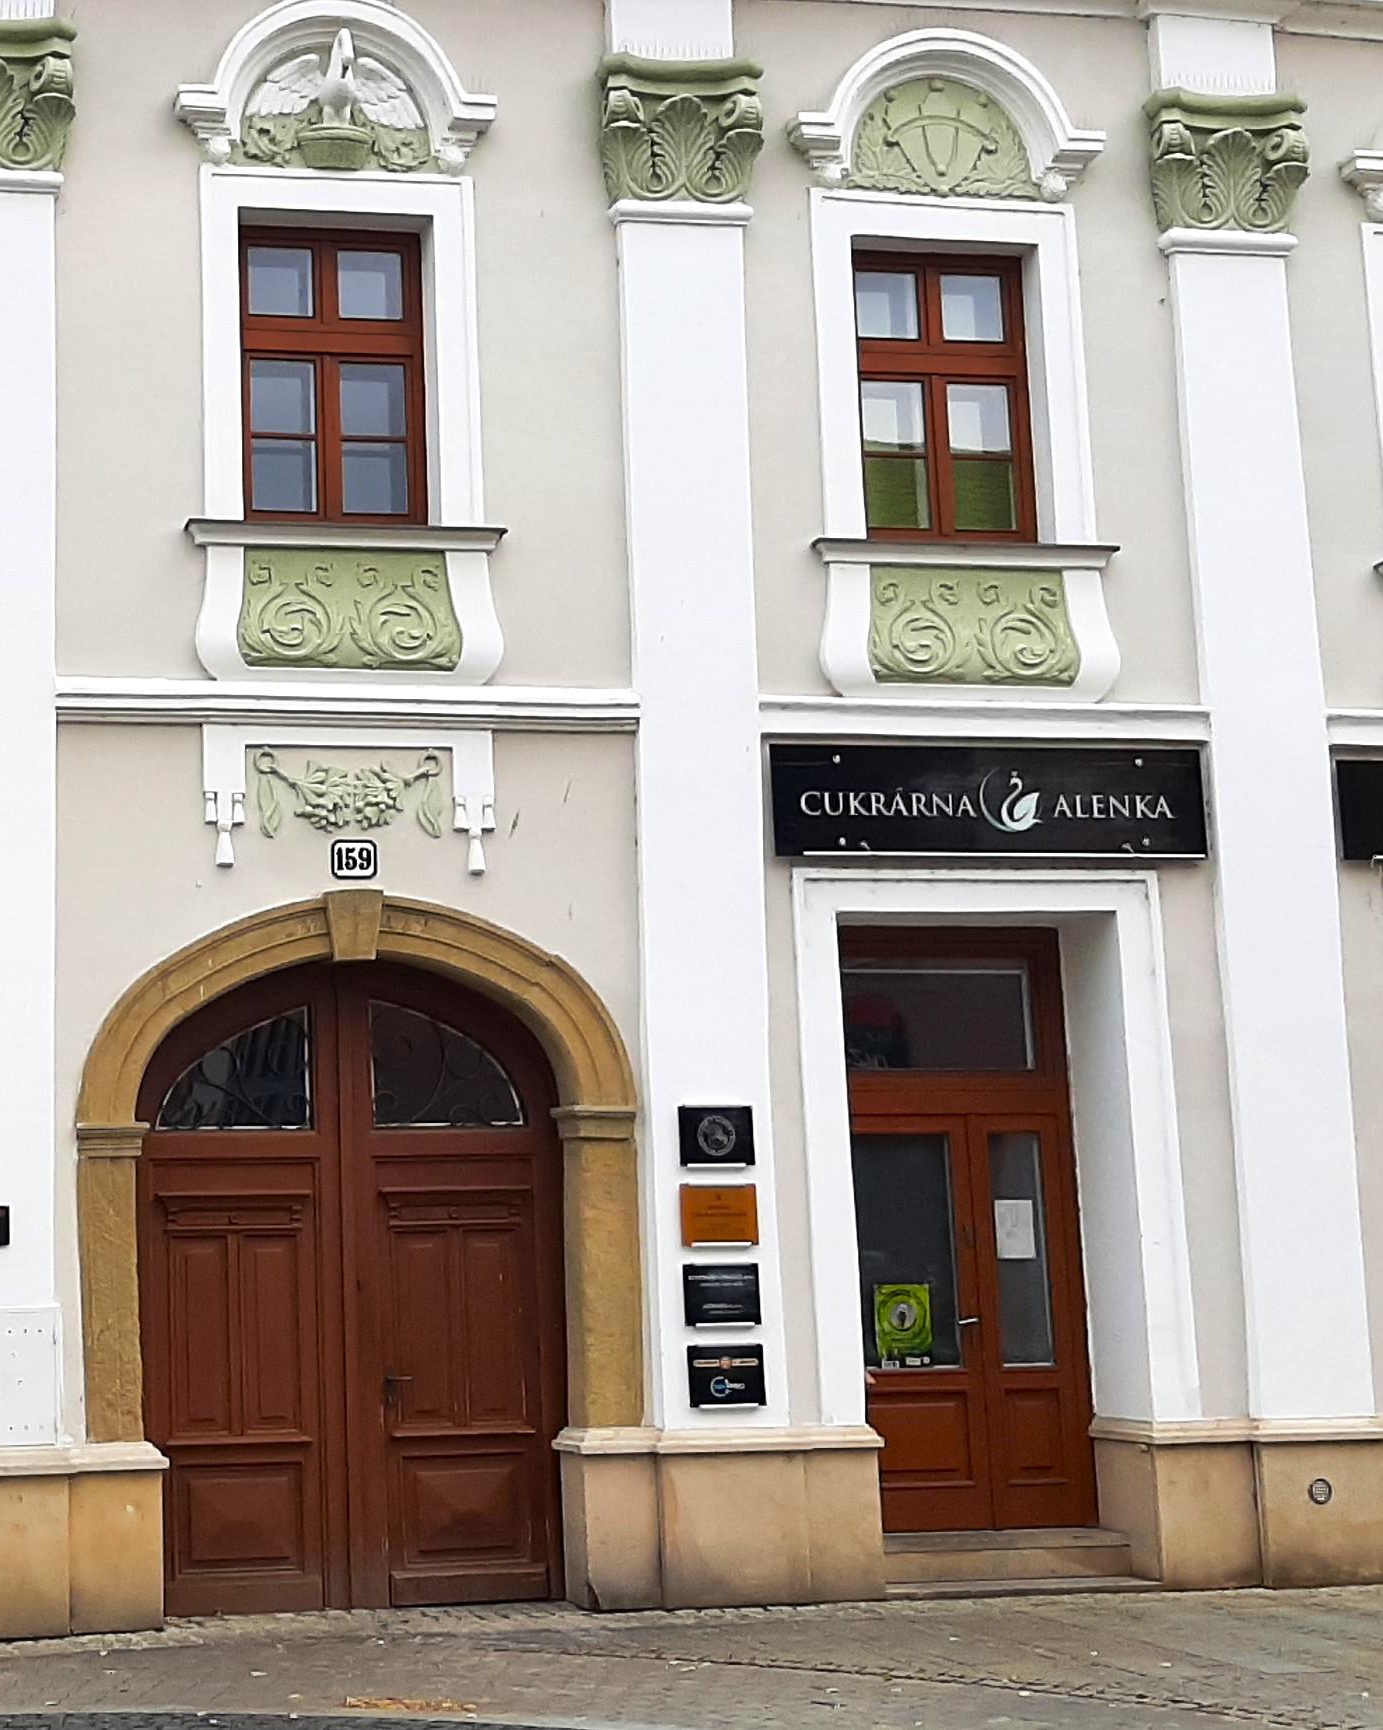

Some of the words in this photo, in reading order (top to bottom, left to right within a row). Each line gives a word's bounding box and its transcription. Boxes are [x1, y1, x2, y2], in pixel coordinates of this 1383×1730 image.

[799, 786, 978, 818] CUKRÁRNA
[1052, 794, 1178, 819] ALENKA
[335, 846, 372, 871] 159
